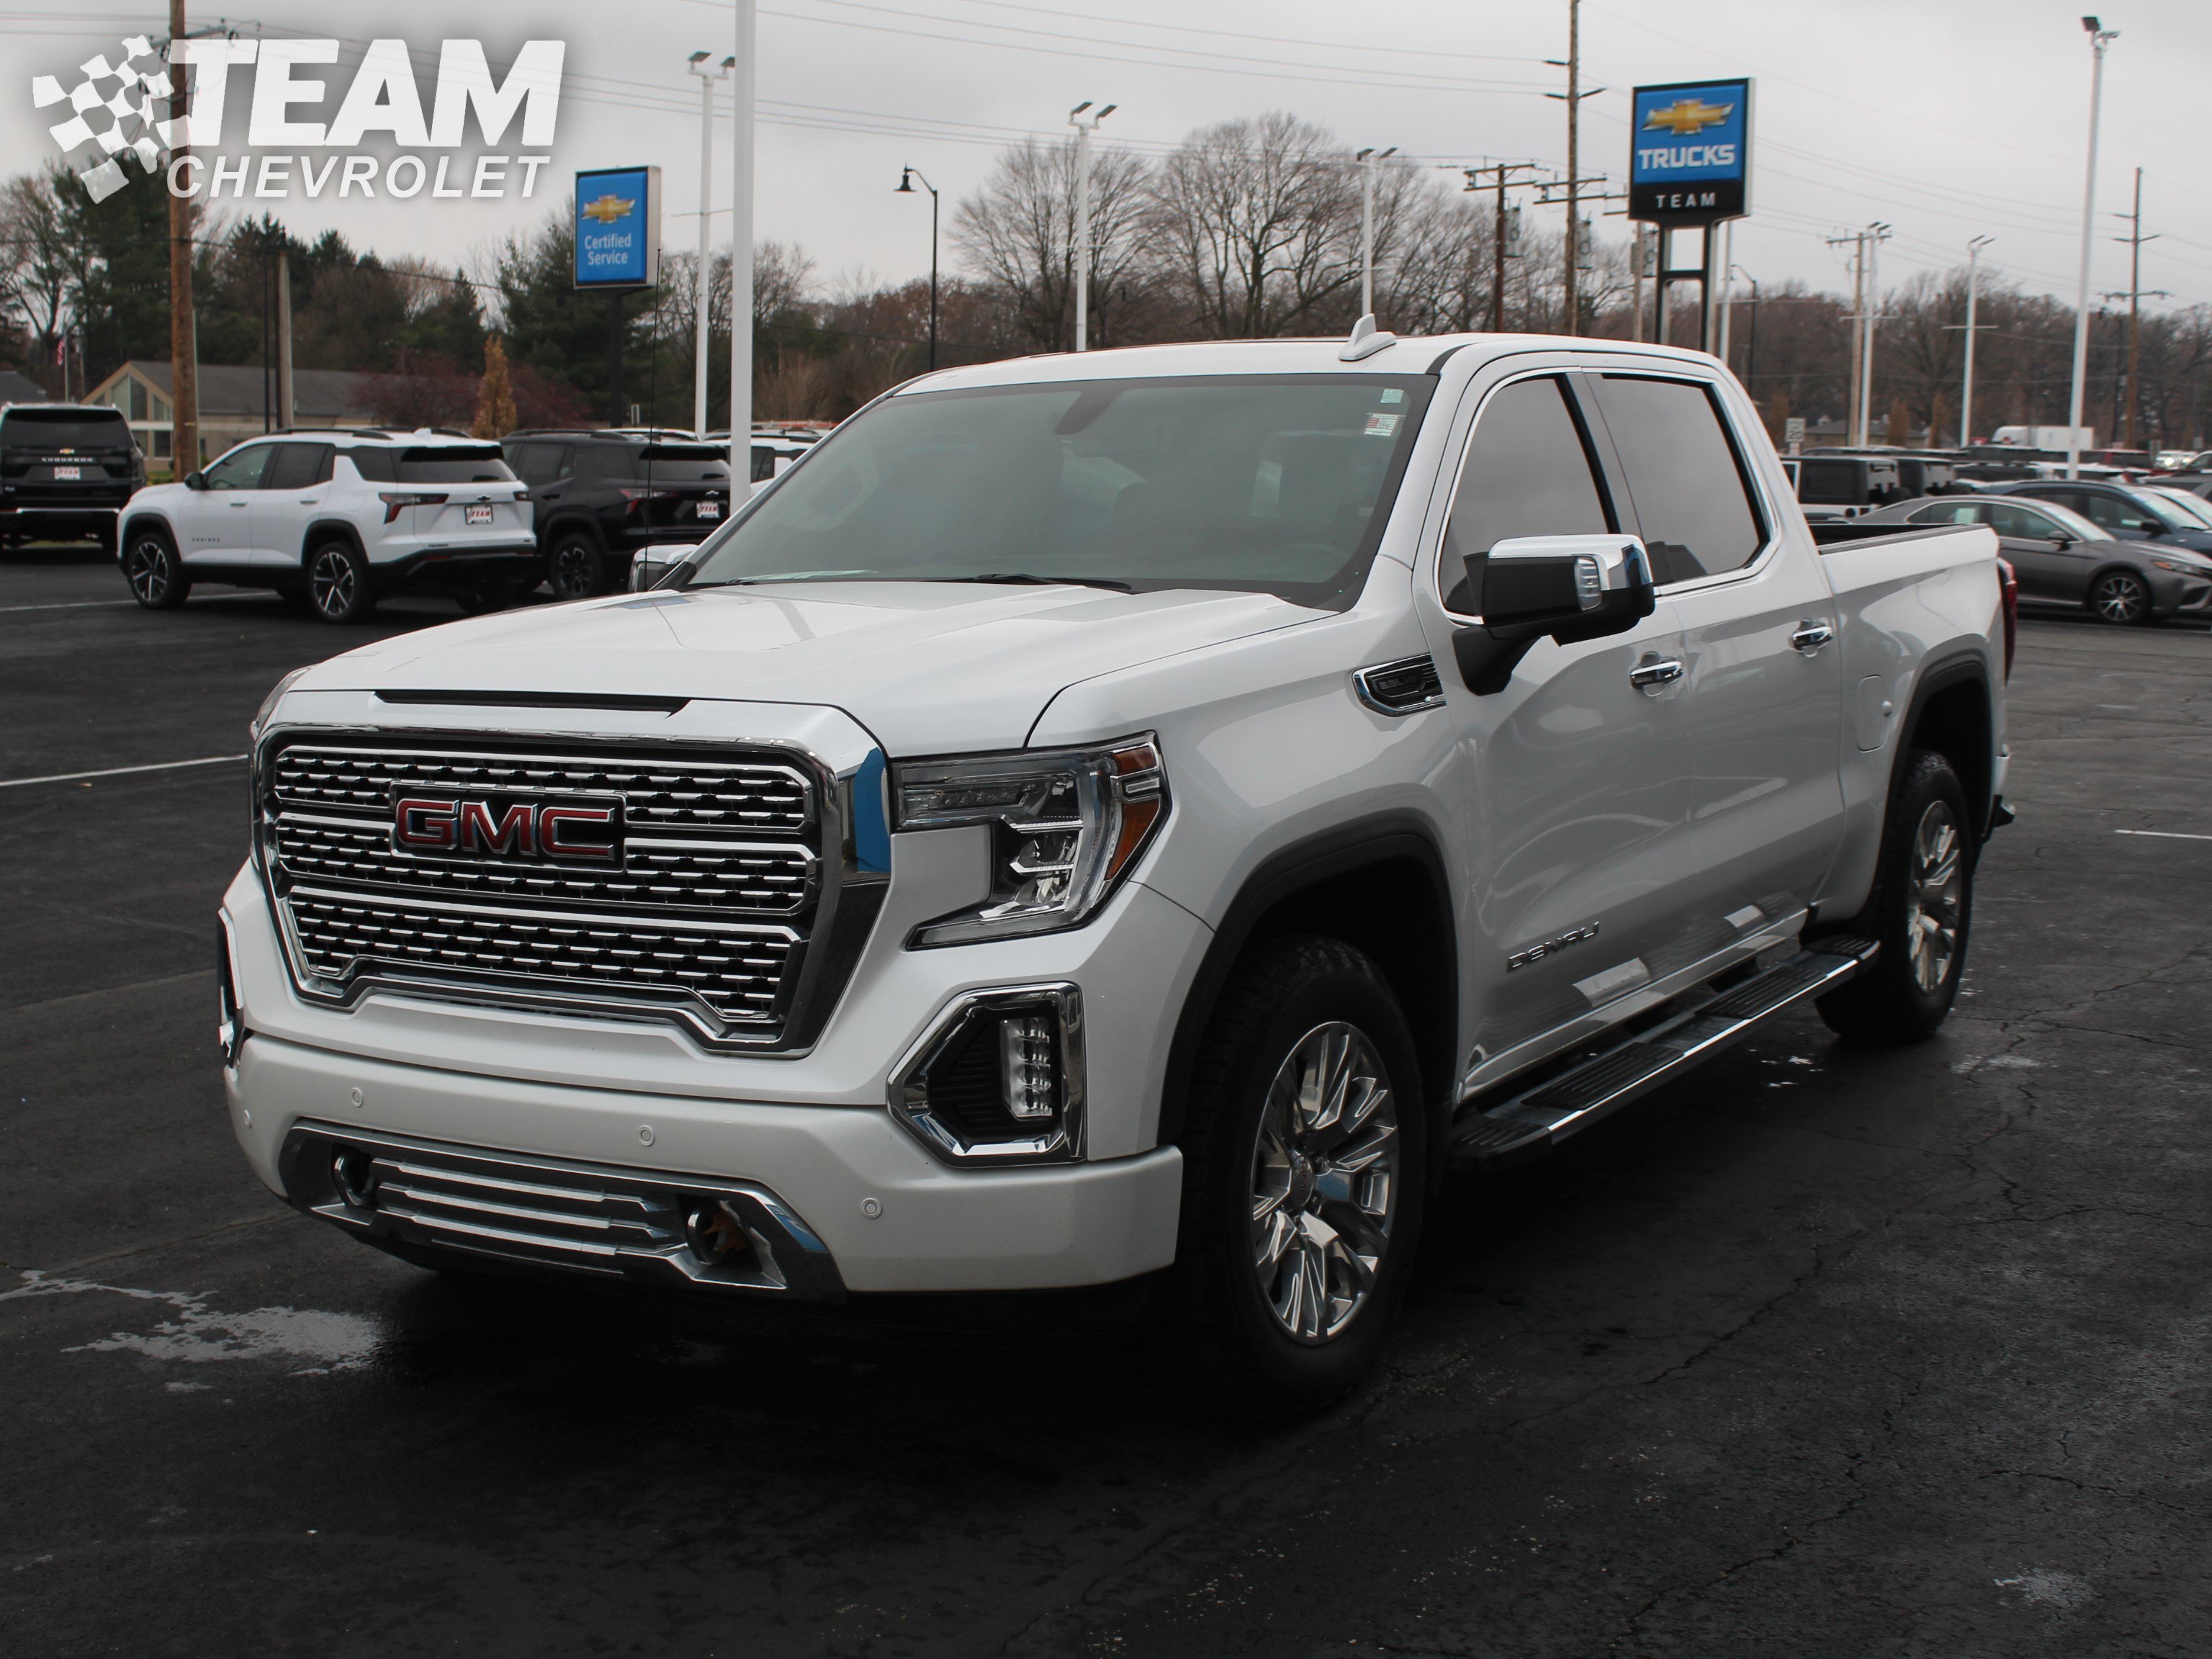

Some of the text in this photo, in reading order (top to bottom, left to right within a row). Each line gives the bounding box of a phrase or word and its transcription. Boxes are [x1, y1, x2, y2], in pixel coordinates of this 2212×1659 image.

[1637, 144, 1736, 170] TRUCKS
[1655, 192, 1717, 209] TEAM
[584, 233, 631, 250] Certified
[588, 250, 629, 266] Service
[396, 798, 616, 860] GMC
[1507, 921, 1600, 973] DENALI
